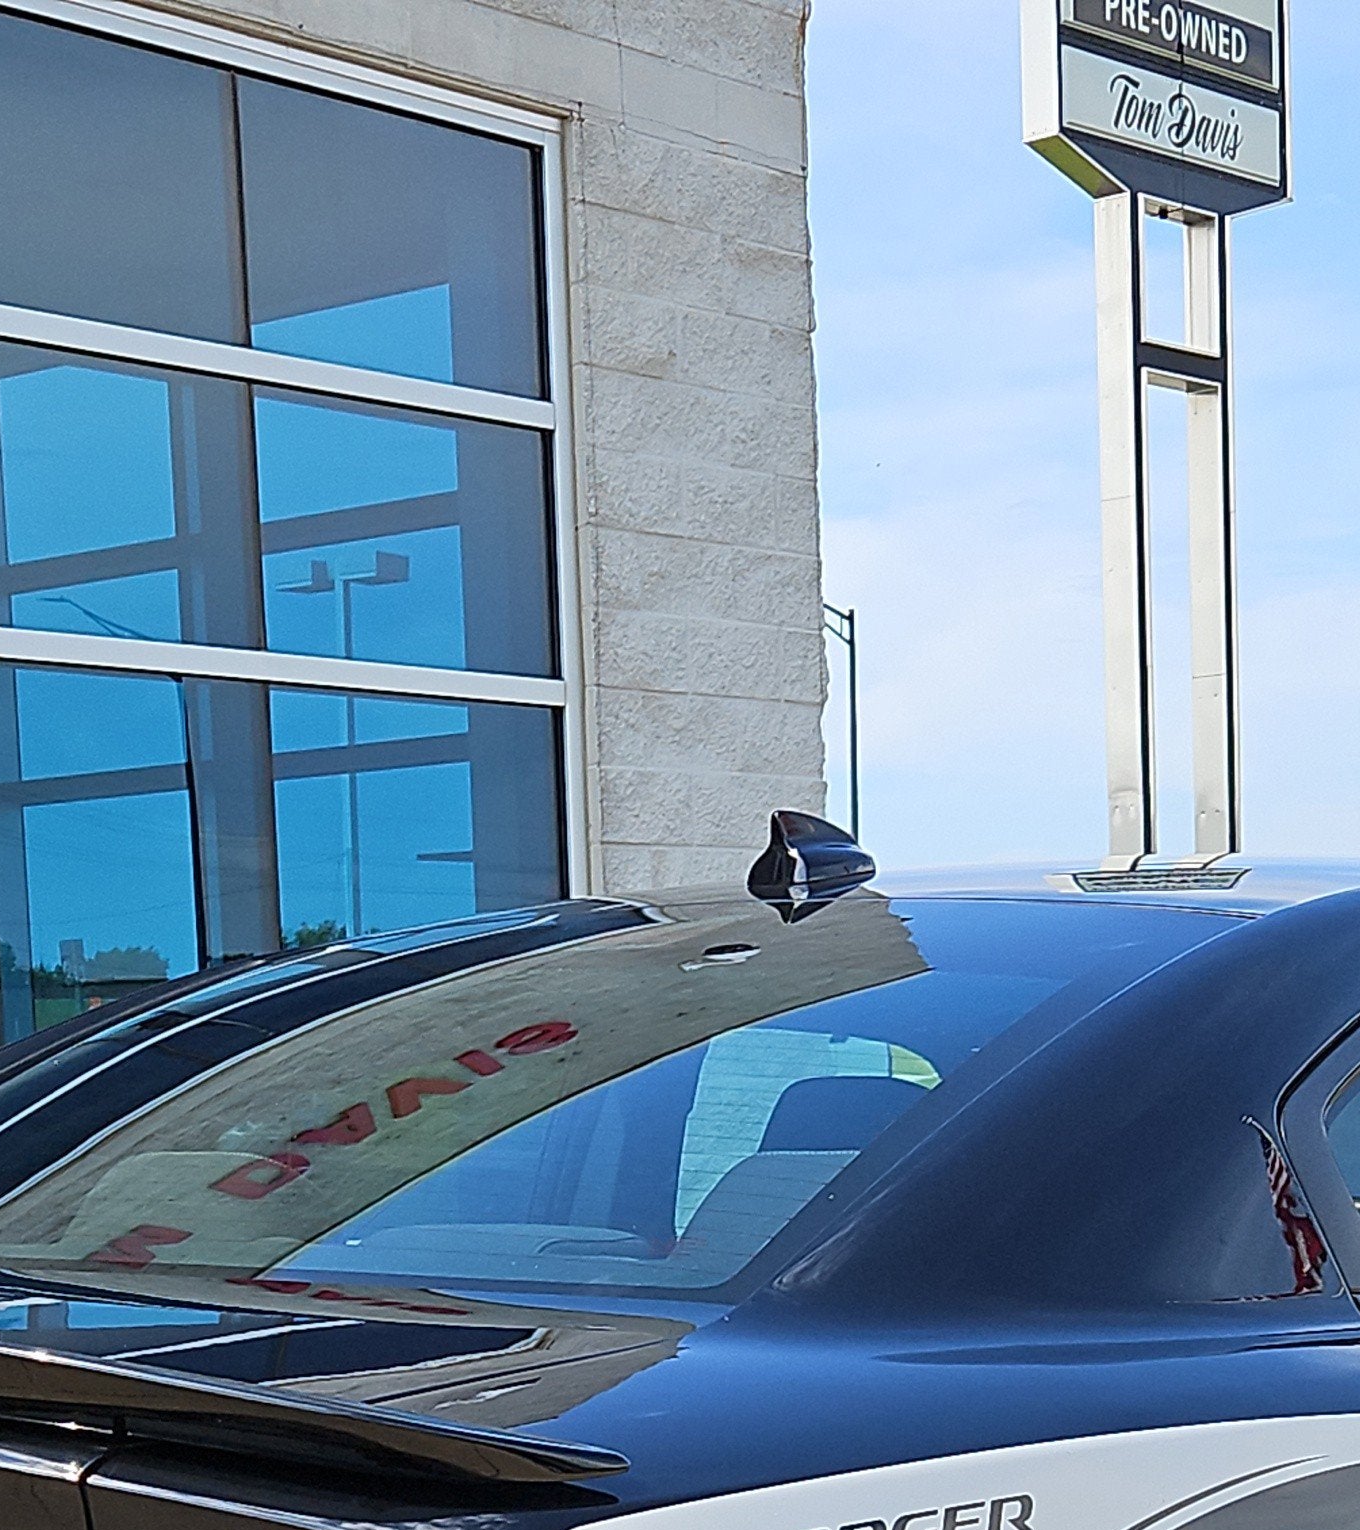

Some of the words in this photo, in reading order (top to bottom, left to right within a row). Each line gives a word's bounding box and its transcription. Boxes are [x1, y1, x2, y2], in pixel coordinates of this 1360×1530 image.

[1104, 0, 1247, 64] PRE-OWNED
[1110, 74, 1163, 139] Tom
[1167, 92, 1243, 161] Davis
